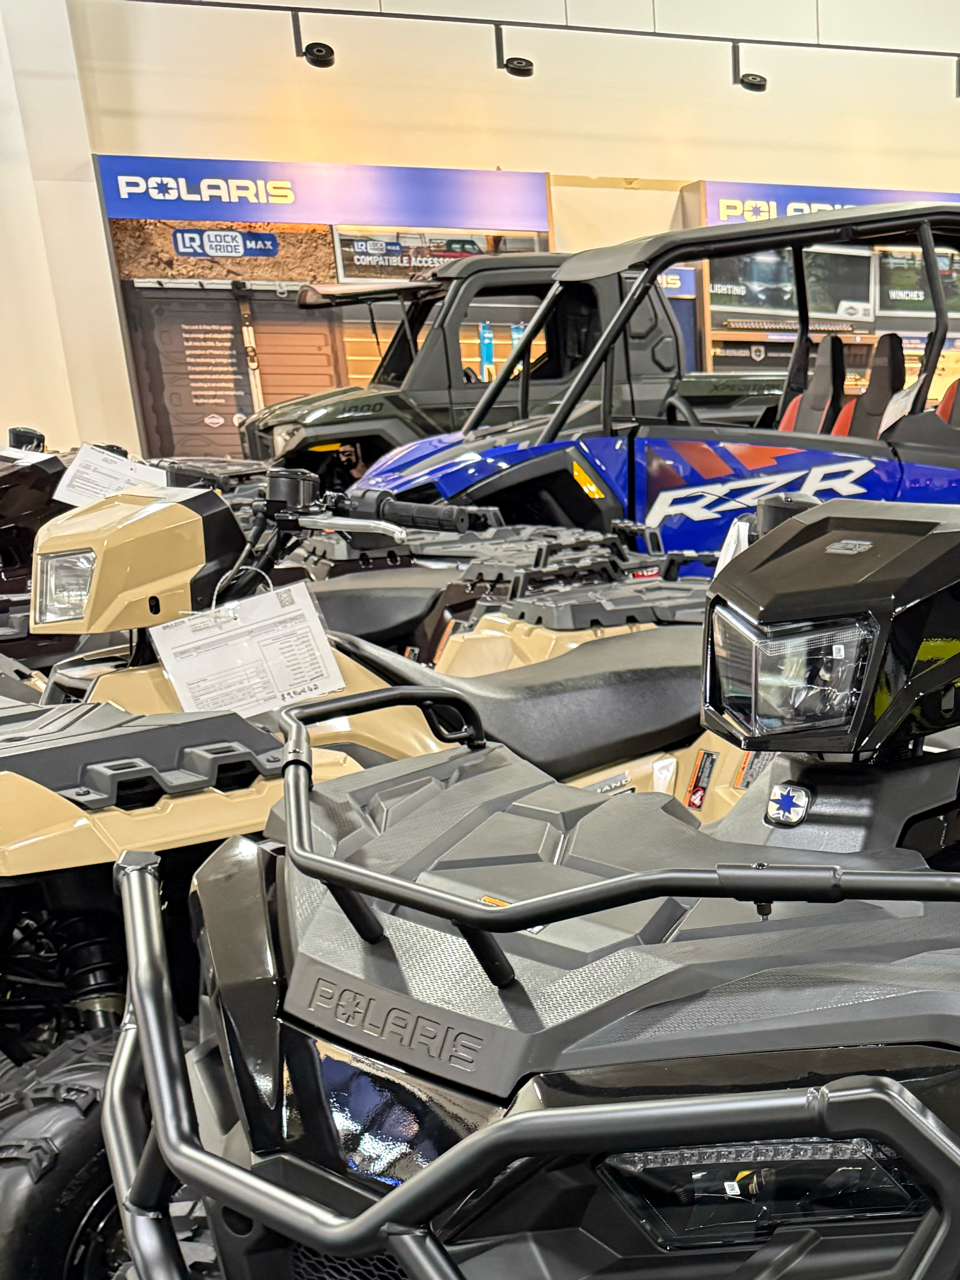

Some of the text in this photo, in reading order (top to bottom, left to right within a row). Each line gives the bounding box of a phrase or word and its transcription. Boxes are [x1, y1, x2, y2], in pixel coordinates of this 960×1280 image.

[117, 175, 295, 204] POLARIS
[718, 199, 858, 223] POLA
[207, 233, 239, 244] LOCK
[245, 240, 273, 250] MAX
[353, 255, 409, 267] COMPATIBLE
[709, 284, 746, 296] LIGHTING
[888, 289, 925, 301] WINCHES
[645, 458, 877, 529] RZR
[307, 977, 484, 1073] POLARIS
